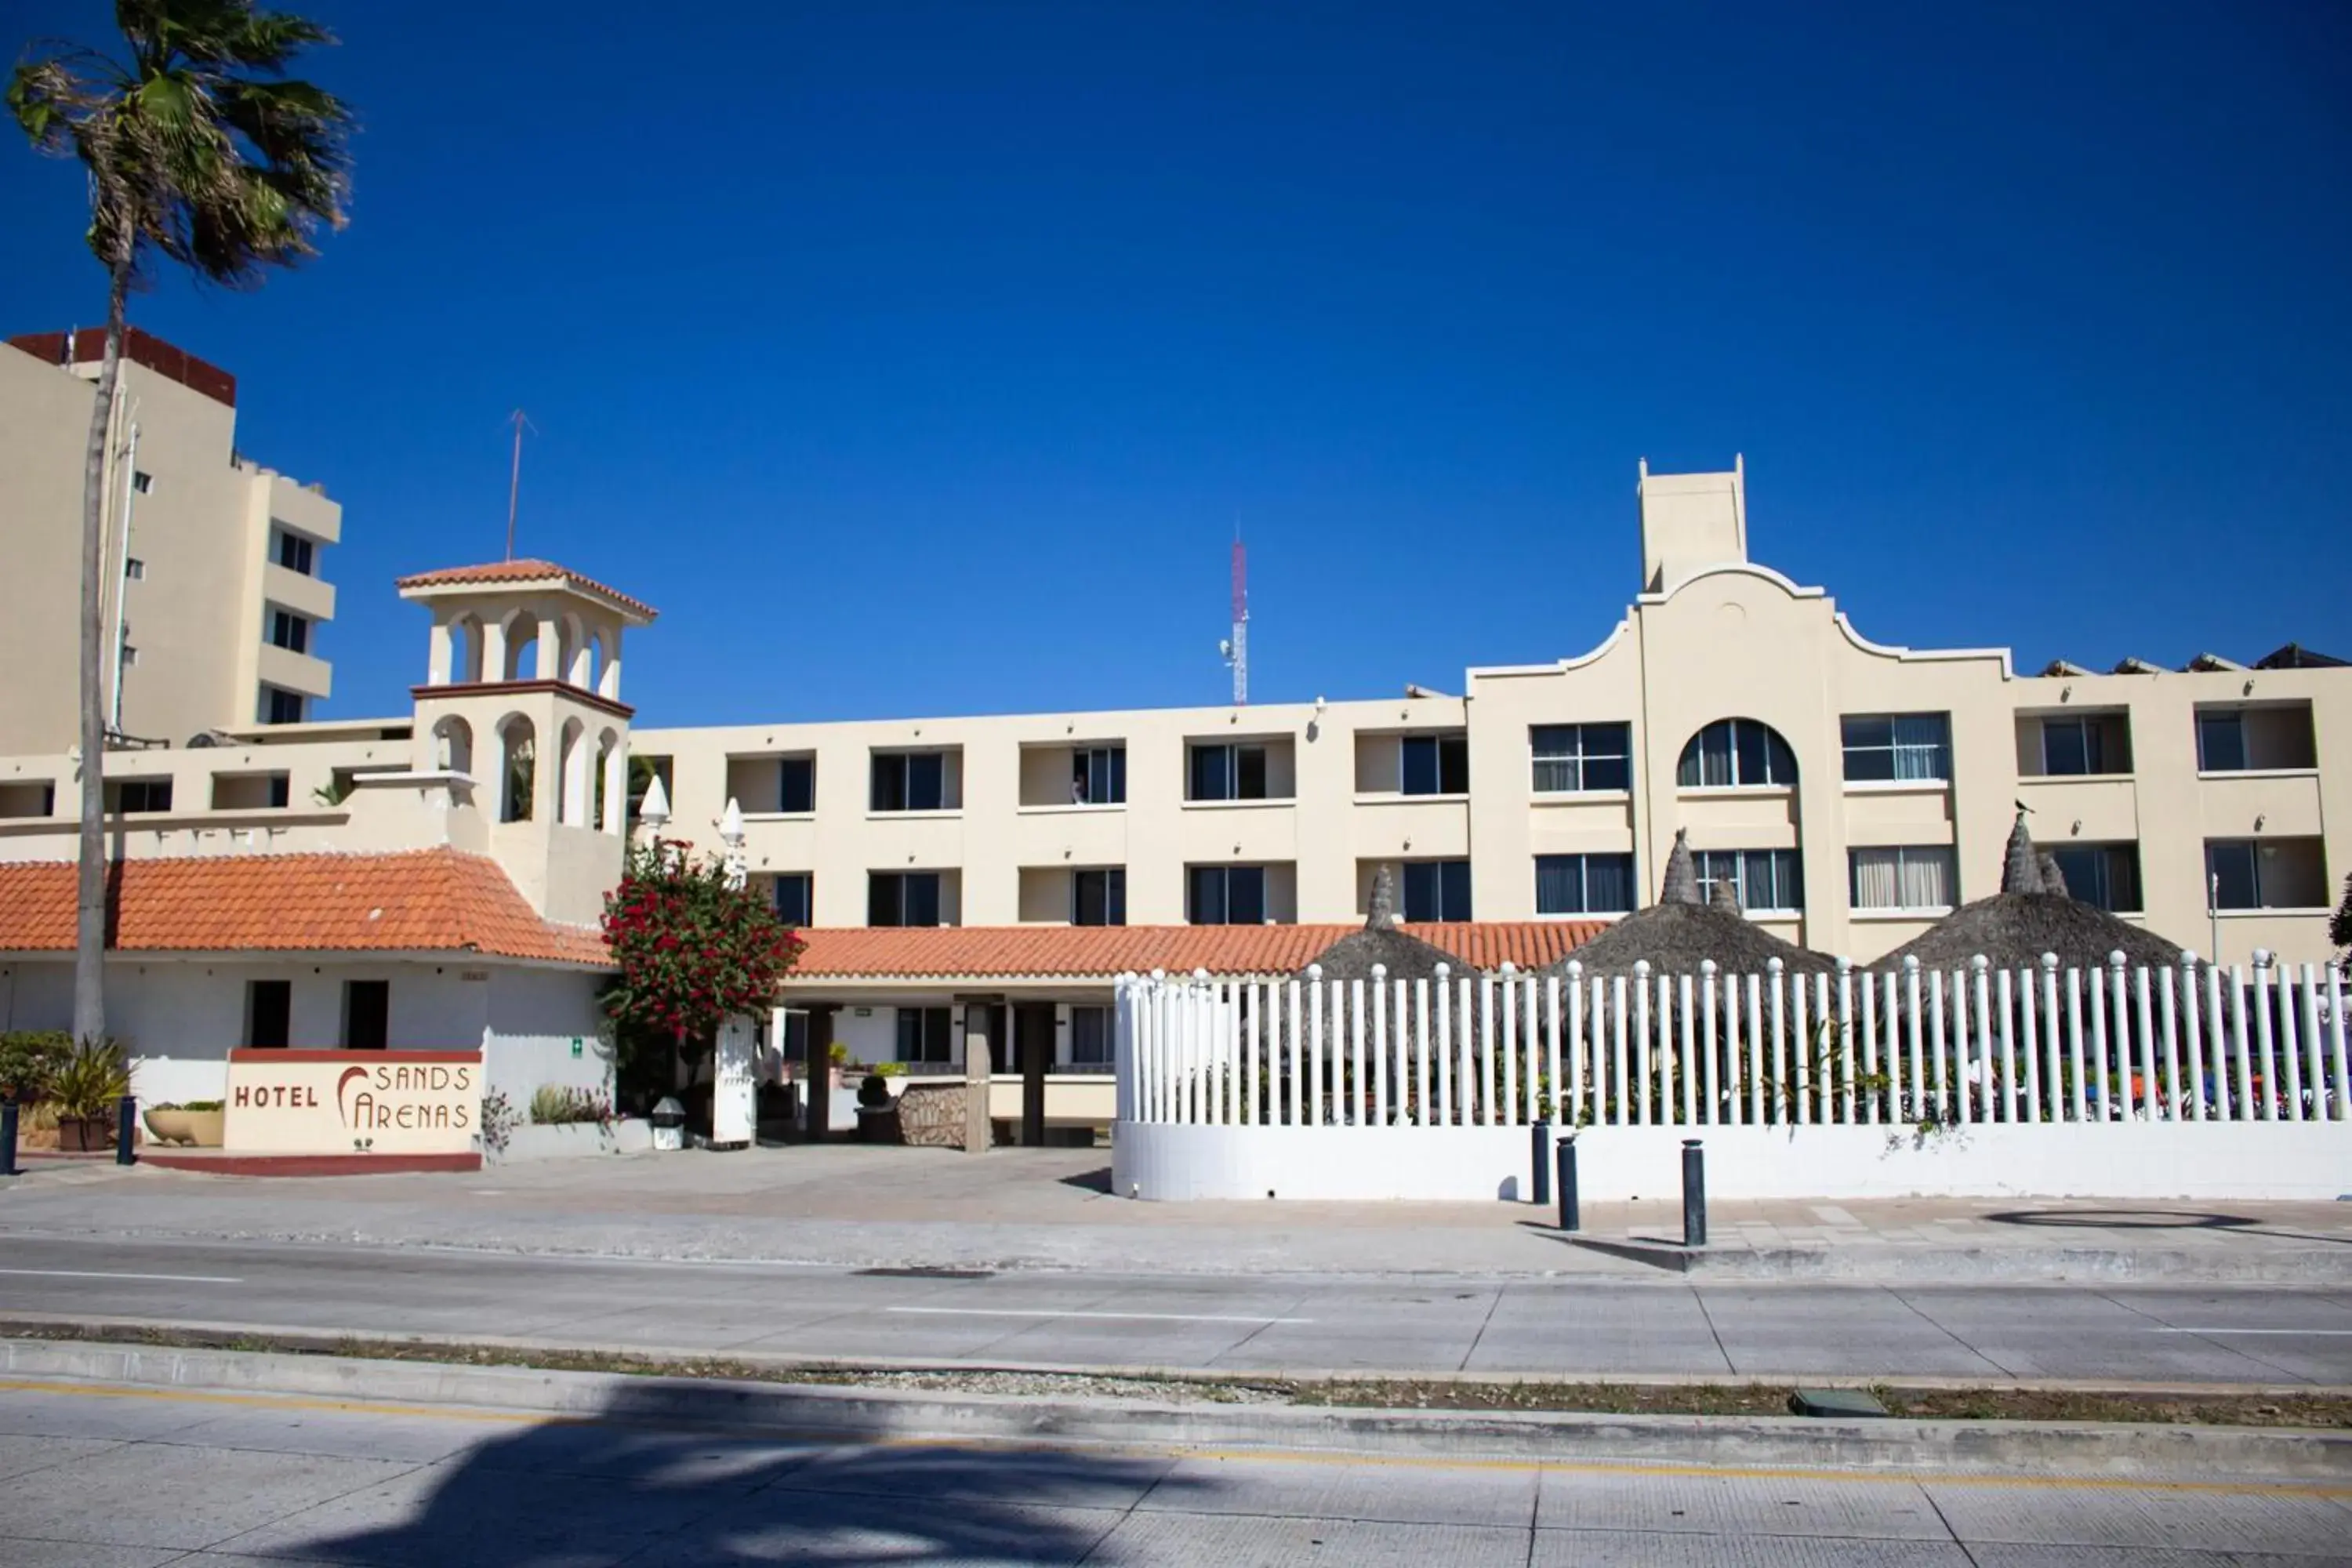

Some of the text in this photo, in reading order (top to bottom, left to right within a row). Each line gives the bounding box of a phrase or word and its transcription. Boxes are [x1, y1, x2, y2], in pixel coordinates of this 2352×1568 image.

[375, 1066, 470, 1091] SANDS
[235, 1086, 318, 1107] HOTEL
[354, 1092, 469, 1129] ARENAS
